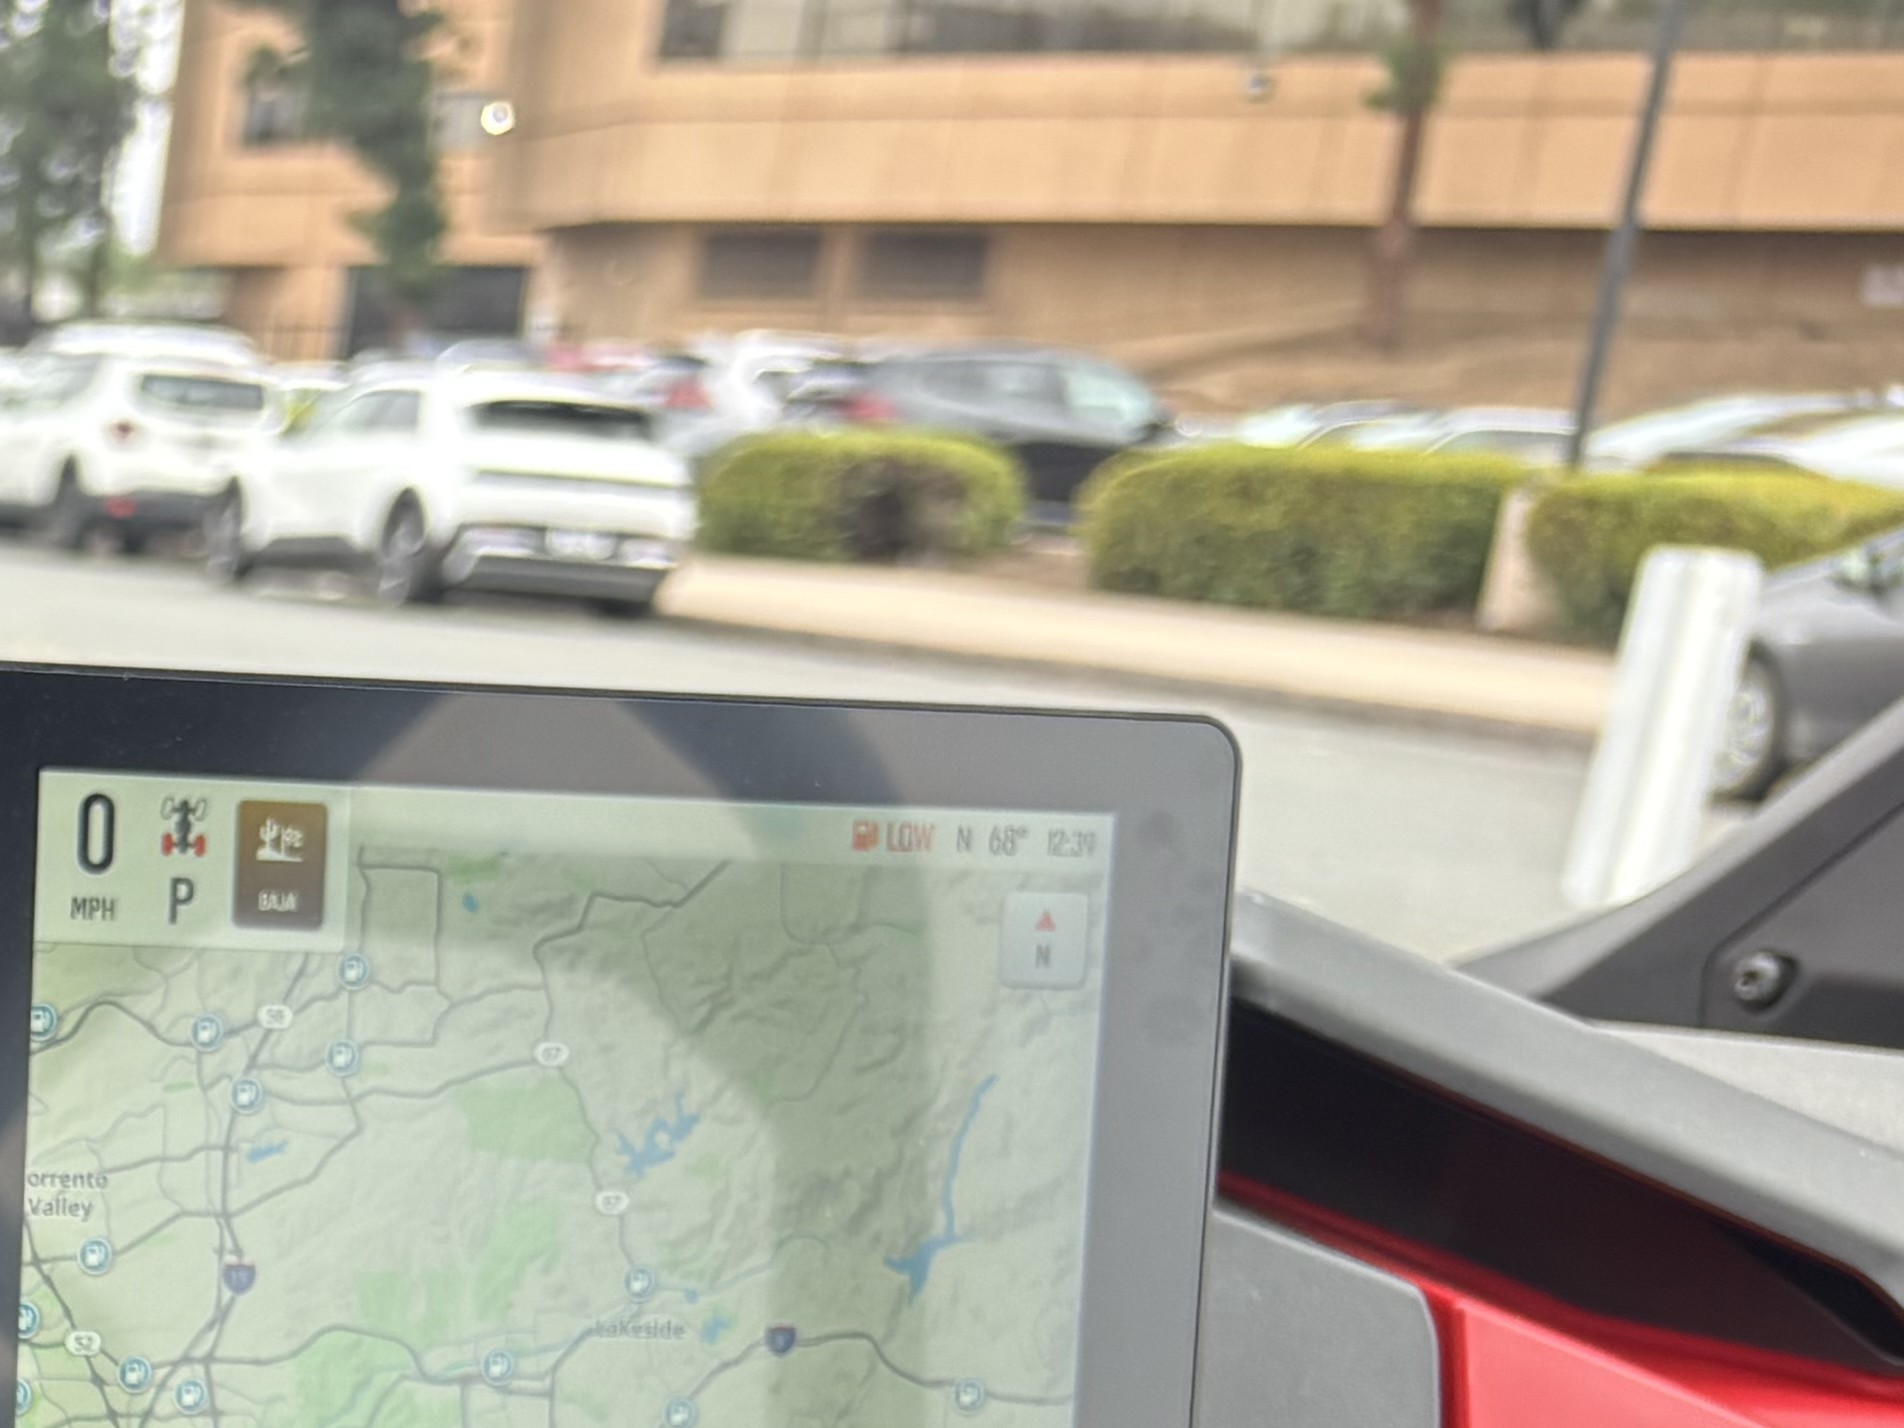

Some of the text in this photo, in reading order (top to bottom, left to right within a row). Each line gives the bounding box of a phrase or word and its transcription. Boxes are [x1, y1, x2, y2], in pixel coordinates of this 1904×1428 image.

[77, 793, 116, 875] 0
[887, 822, 935, 853] LOW
[956, 826, 972, 852] N
[70, 898, 115, 920] MPH
[169, 878, 195, 924] P
[27, 1170, 108, 1189] orrento
[28, 1197, 93, 1222] Valley
